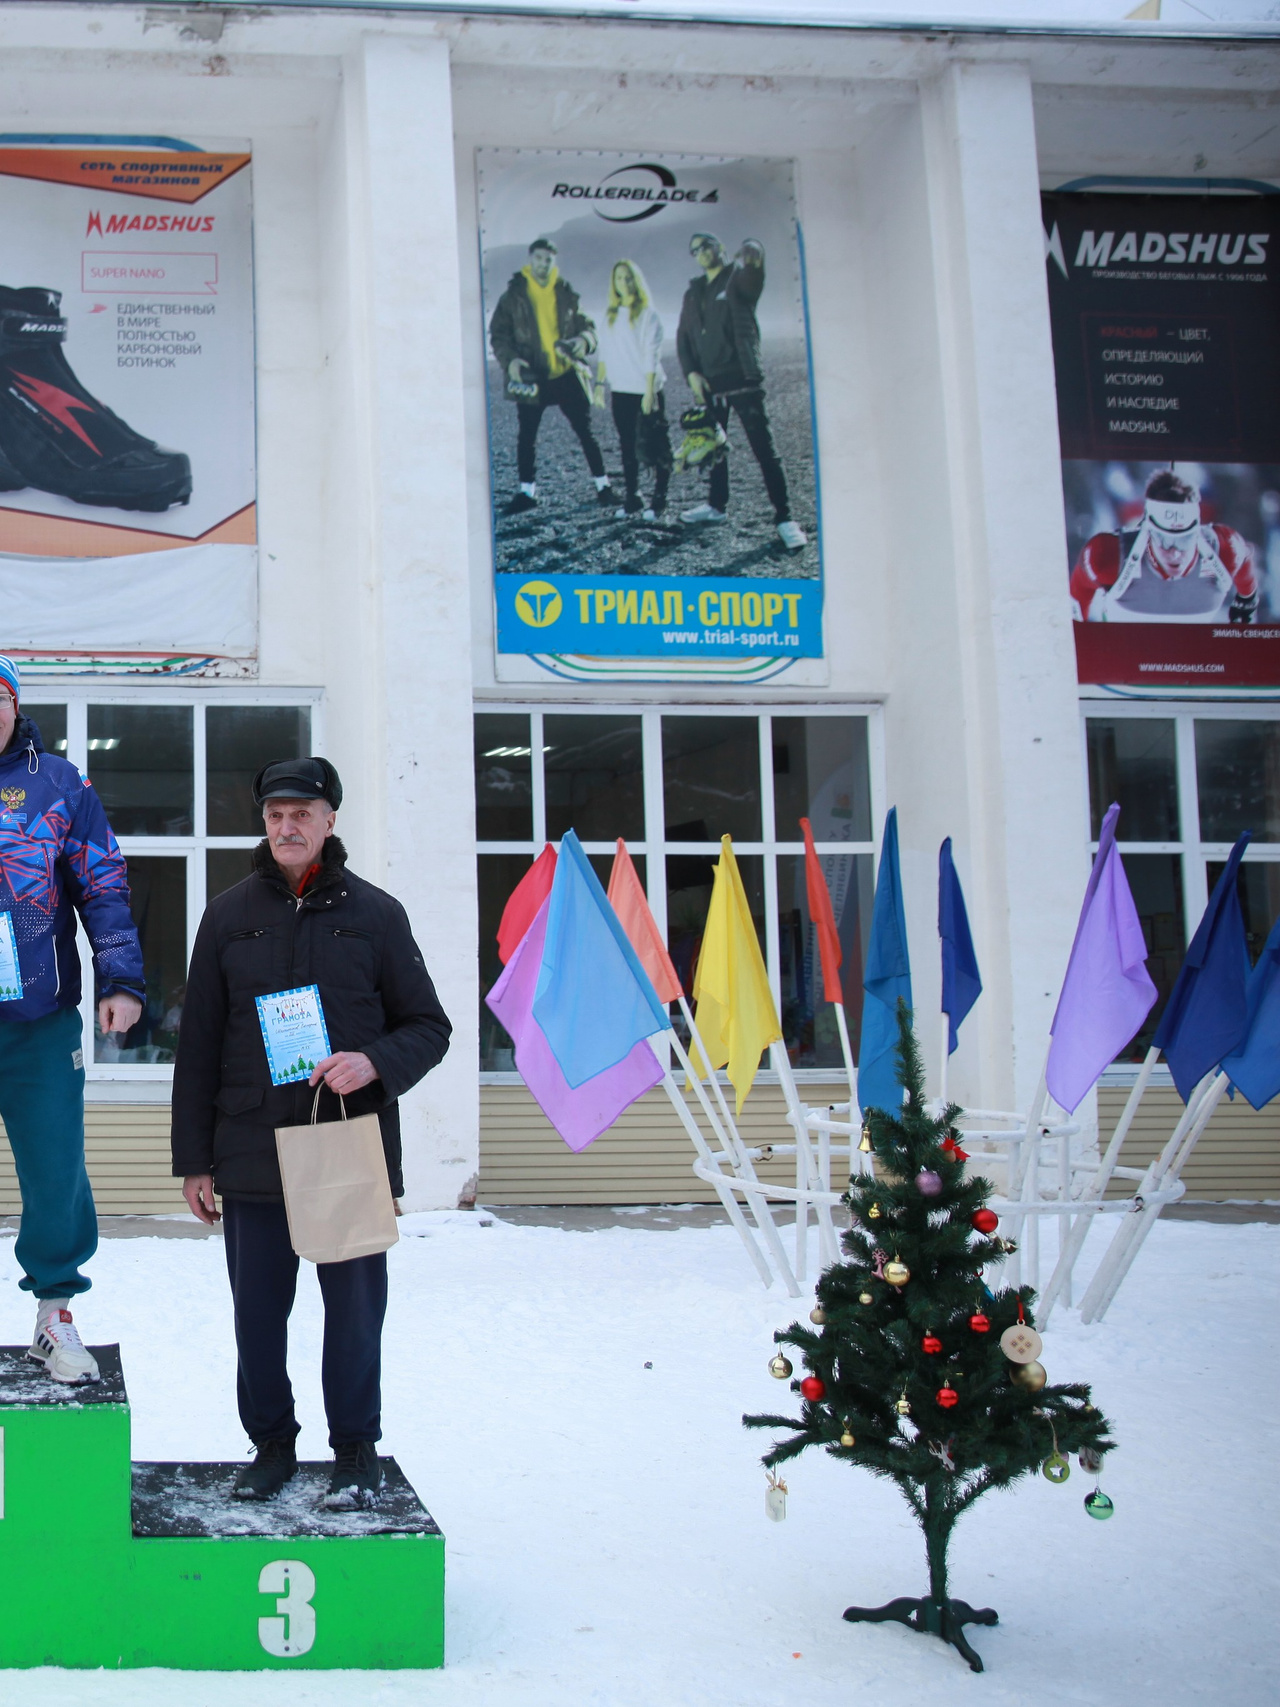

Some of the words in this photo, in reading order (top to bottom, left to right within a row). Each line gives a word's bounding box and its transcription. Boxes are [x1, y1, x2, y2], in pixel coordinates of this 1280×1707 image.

[80, 162, 115, 172] сеть
[121, 161, 223, 174] спортивных
[112, 174, 200, 186] магазинов
[551, 183, 699, 203] ROLLERBLADE
[105, 214, 215, 234] MADSHUS
[1074, 230, 1270, 268] MADSHUS
[91, 267, 127, 279] SUPER
[130, 268, 165, 279] NANO
[117, 302, 215, 315] ЕДИНСТВЕННЫЙ
[117, 317, 124, 328] В
[127, 317, 161, 328] МИРЕ
[117, 330, 196, 341] ПОЛНОСТЬЮ
[117, 342, 202, 355] КАРБОНОВЫЙ
[117, 357, 176, 368] БОТИНОК
[1102, 349, 1204, 365] ОПРЕДЕЛЯЮЩИЙ
[1104, 373, 1164, 386] ИСТОРИЮ
[1107, 396, 1116, 408] И
[1118, 396, 1180, 412] НАСЛЕДИЕ
[662, 630, 799, 648] www.trial-sport.ru
[1139, 663, 1225, 672] WWW.MADSHUS.COM
[271, 1010, 313, 1026] ГРАМОТА
[258, 1560, 316, 1658] 3
